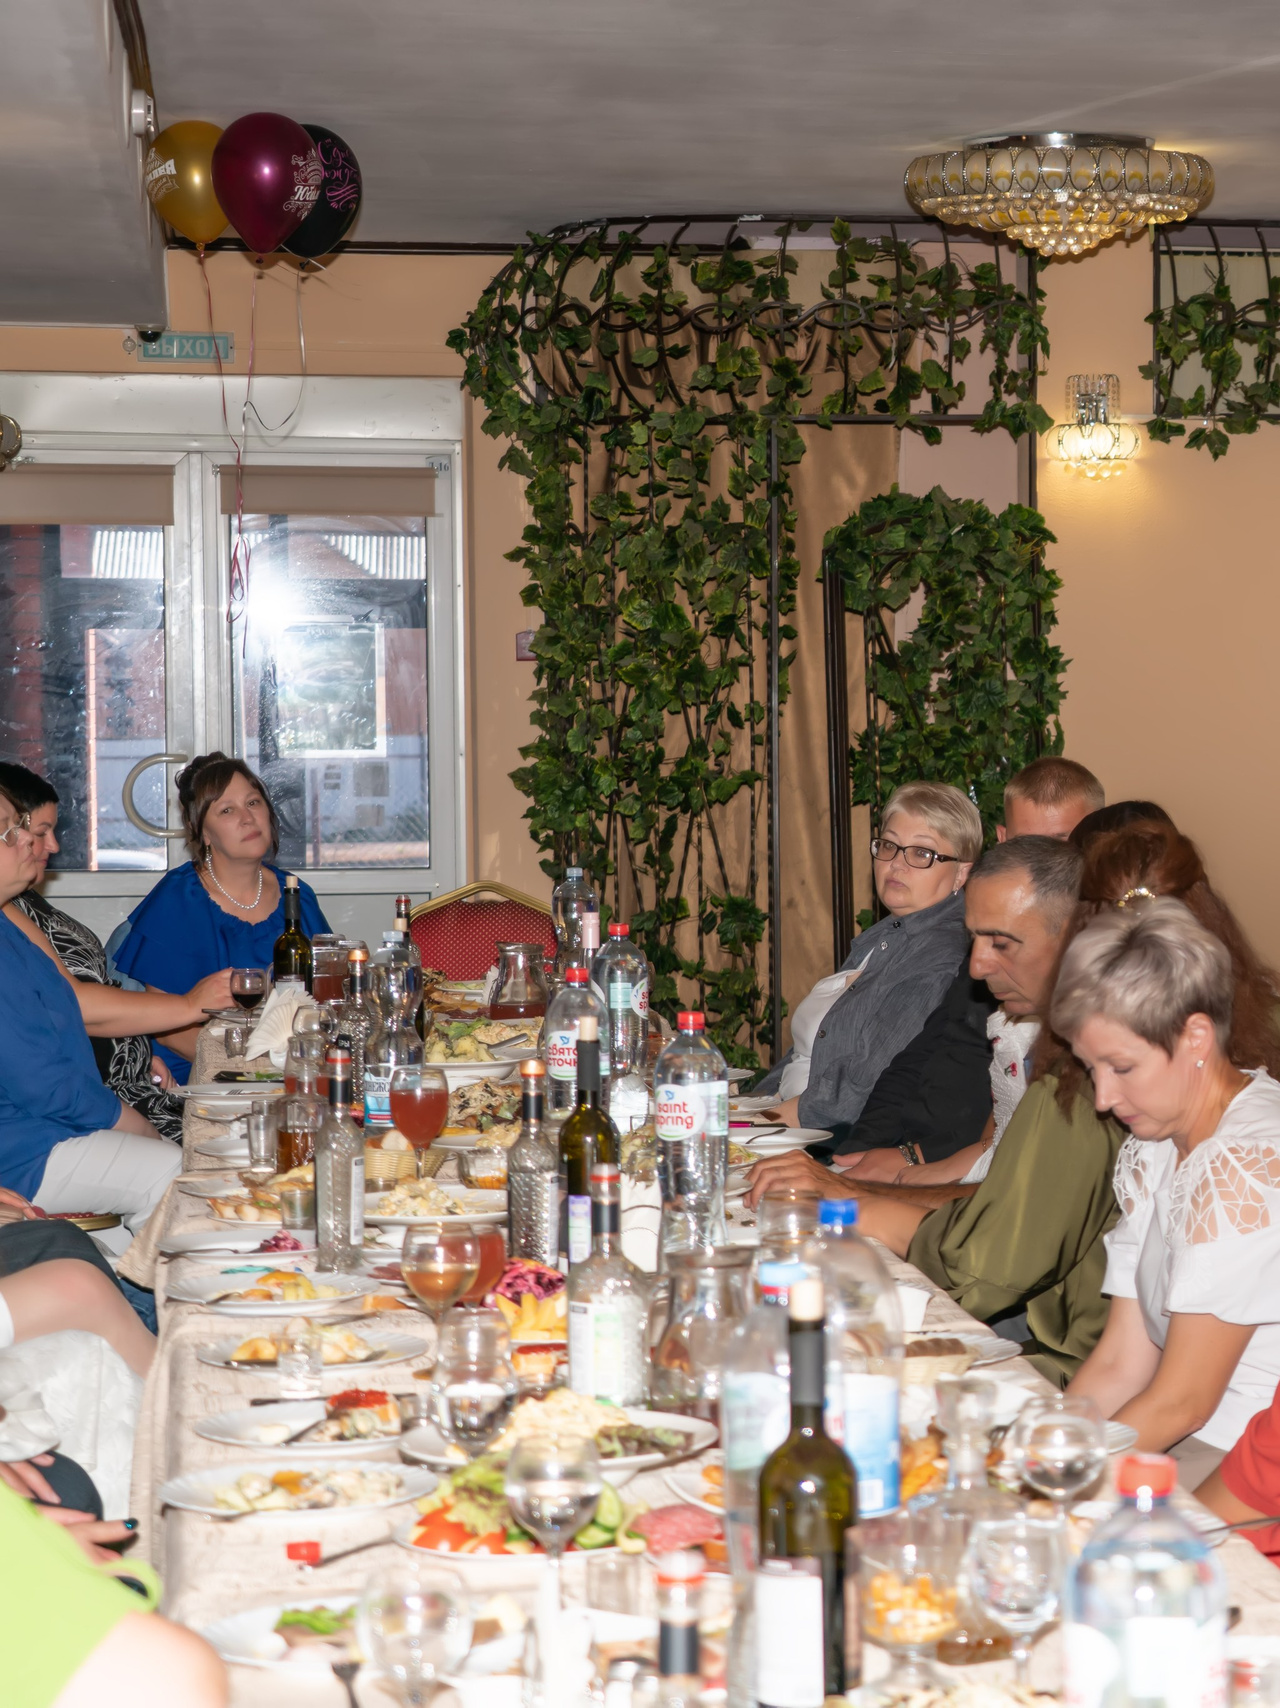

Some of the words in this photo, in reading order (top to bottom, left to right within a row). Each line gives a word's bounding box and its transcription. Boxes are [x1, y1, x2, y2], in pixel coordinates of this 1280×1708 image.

[147, 337, 226, 359] ВЫХОД
[657, 1100, 688, 1114] saint
[656, 1115, 694, 1130] spring
